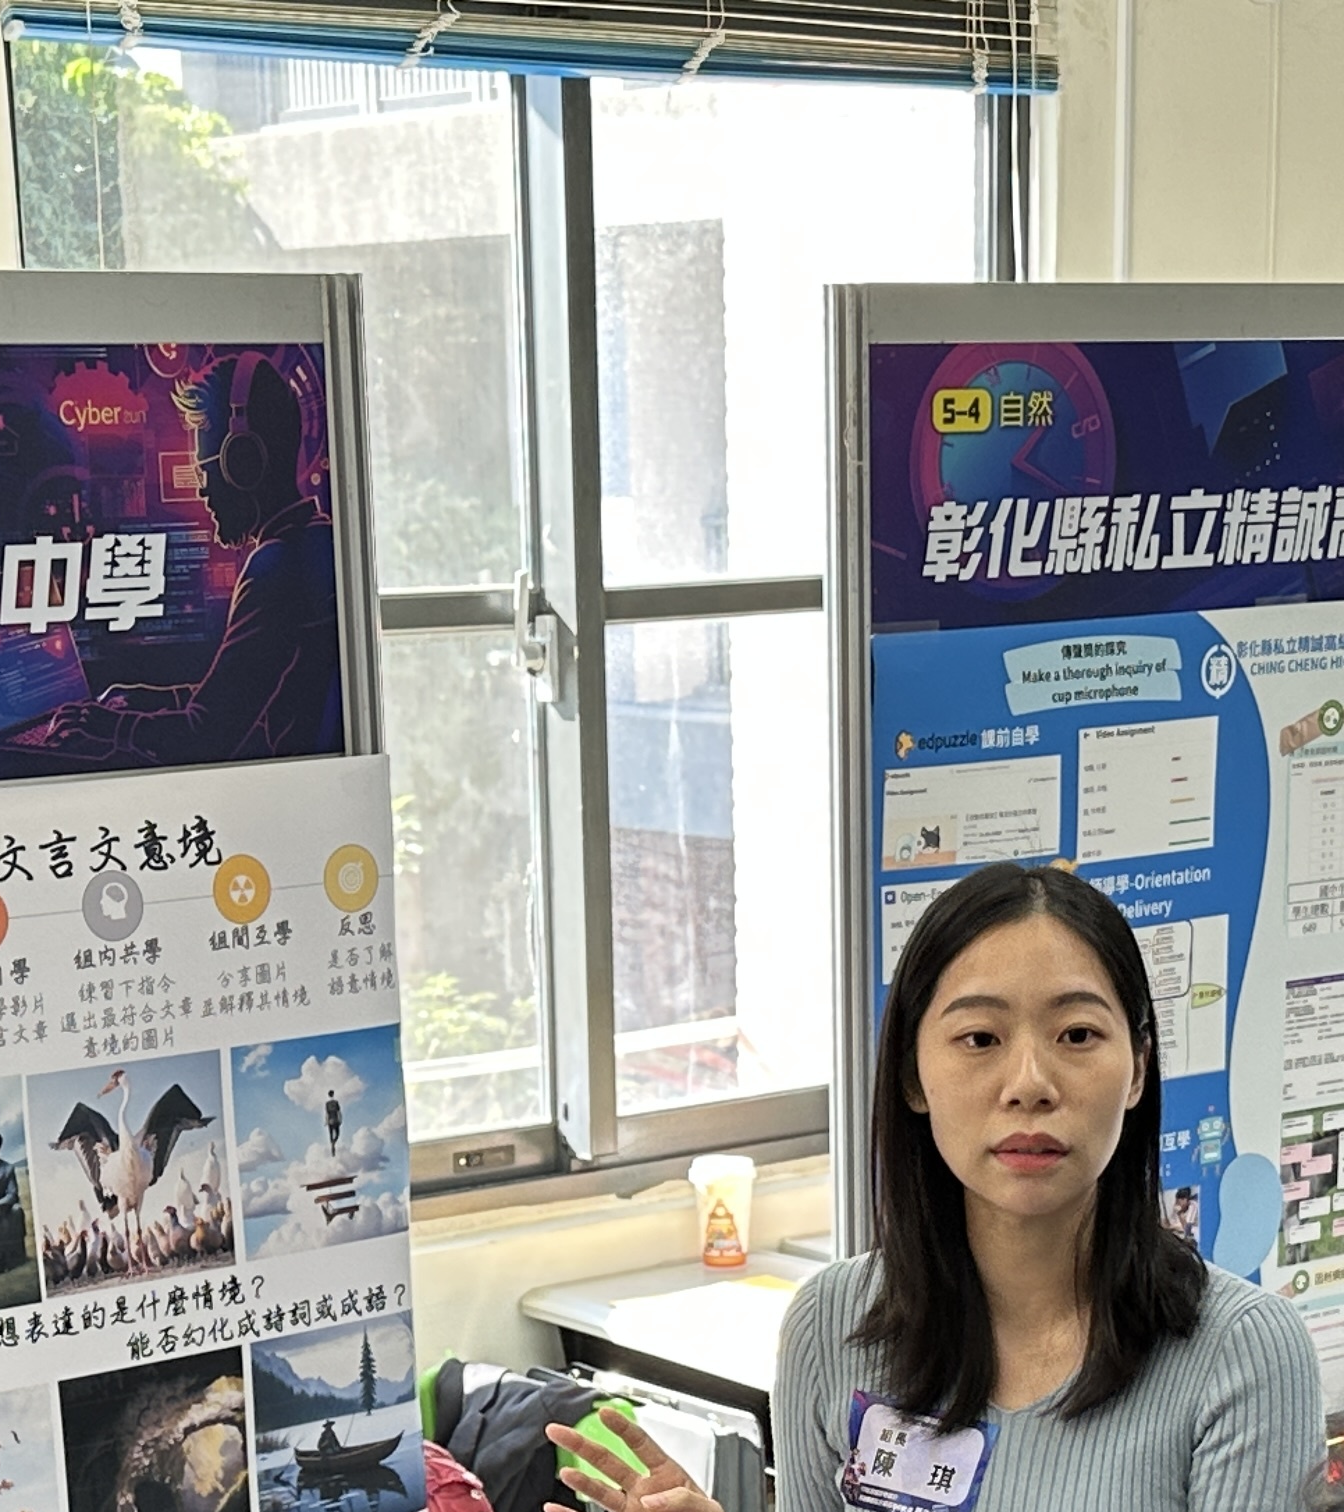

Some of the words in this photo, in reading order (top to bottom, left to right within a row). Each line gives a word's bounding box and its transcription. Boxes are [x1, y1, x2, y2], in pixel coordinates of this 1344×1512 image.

[58, 399, 122, 432] Cyber
[942, 399, 982, 425] 5-4
[999, 390, 1056, 429] 自然
[1022, 668, 1051, 684] Make
[1062, 662, 1113, 682] thorough
[1155, 659, 1167, 673] of
[1250, 659, 1286, 676] CHING
[1287, 656, 1328, 673] CHENG
[1051, 690, 1072, 705] cup
[1074, 684, 1139, 703] microphone
[917, 731, 978, 752] edpuzzle
[73, 937, 163, 971] 組內共學
[208, 921, 294, 952] 組間互學
[337, 912, 376, 938] 反思
[1160, 1130, 1191, 1152] 互學
[871, 1448, 898, 1478] 陳
[927, 1464, 956, 1495] 琪
